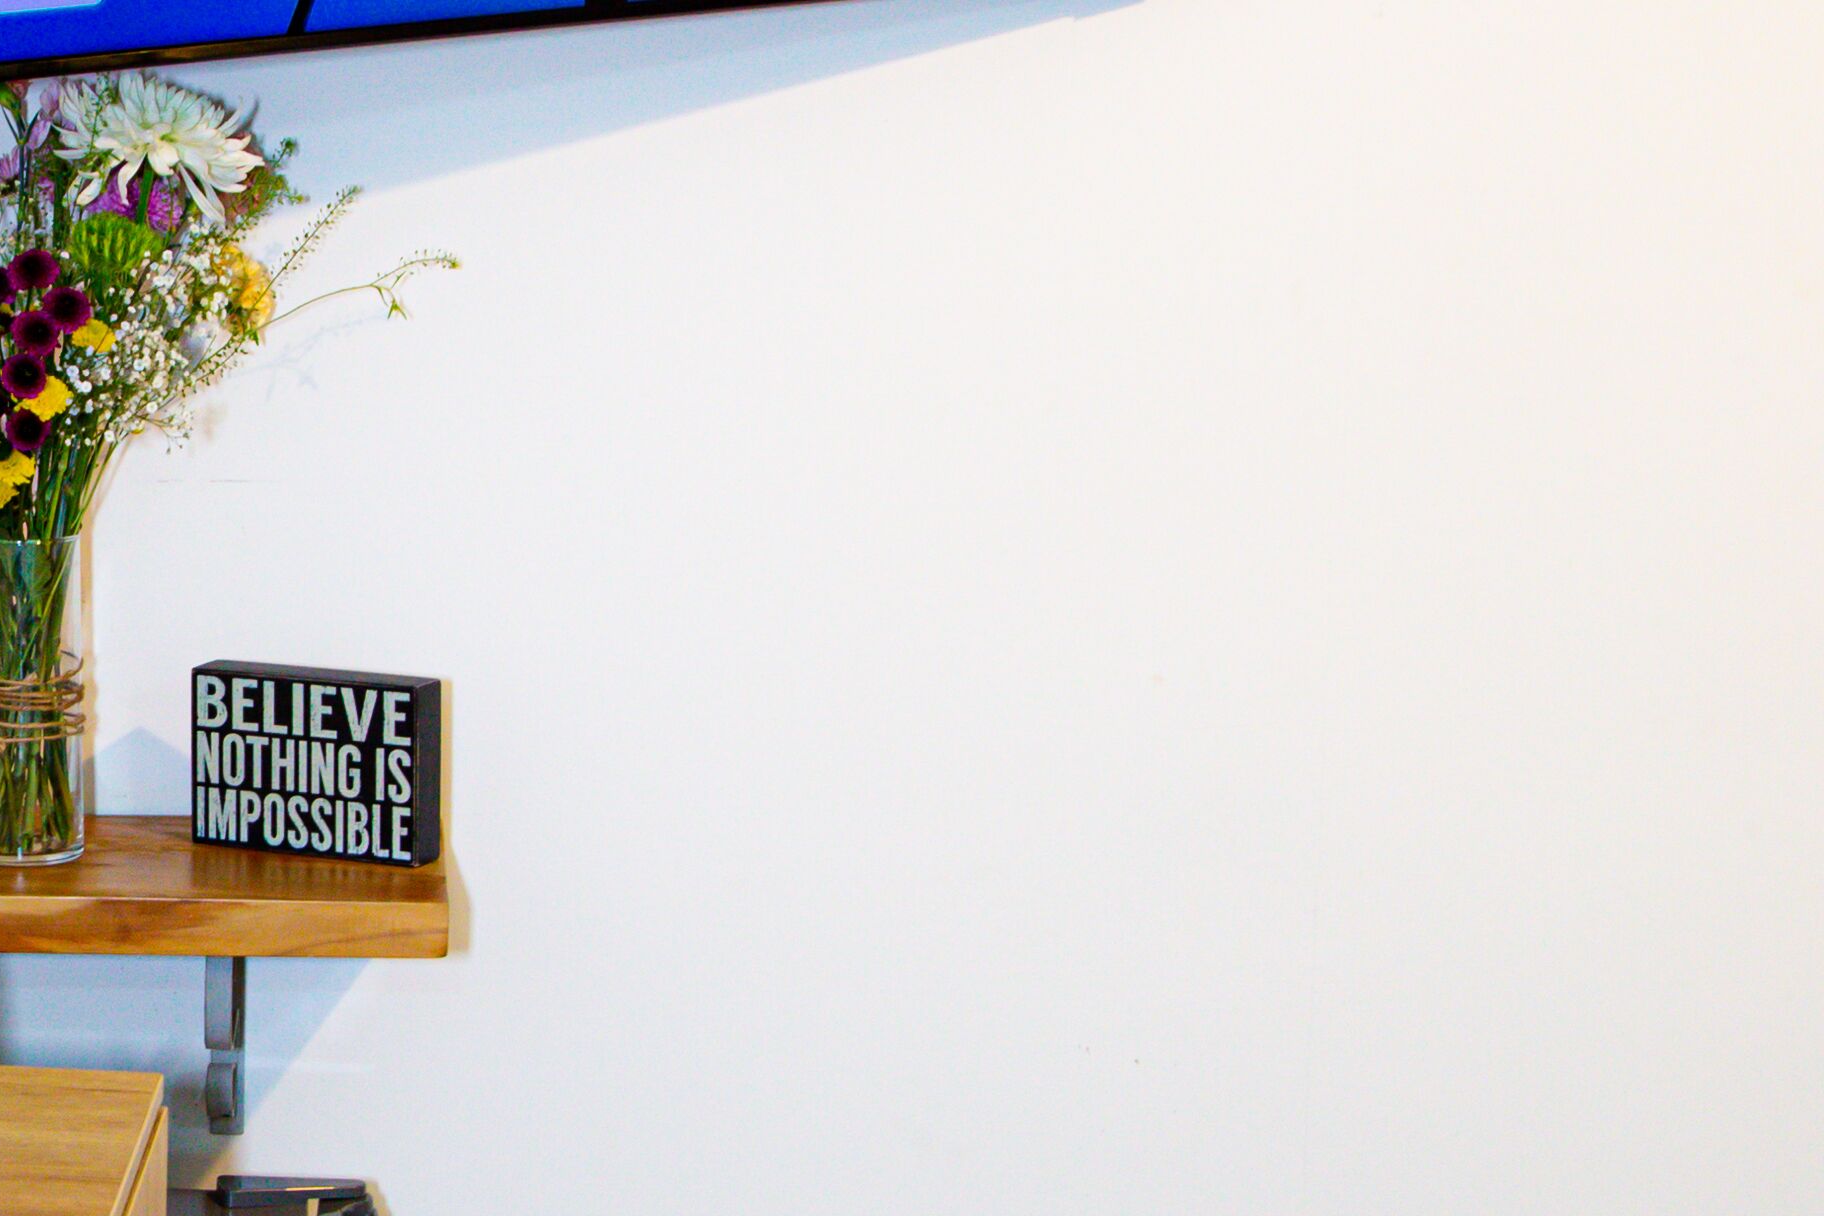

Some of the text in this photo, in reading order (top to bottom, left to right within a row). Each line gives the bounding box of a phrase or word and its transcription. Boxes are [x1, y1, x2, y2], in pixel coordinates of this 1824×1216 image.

[196, 674, 411, 746] BELIEVE
[196, 730, 411, 804] NOTHING IS
[196, 785, 411, 860] IMPOSSIBLE
